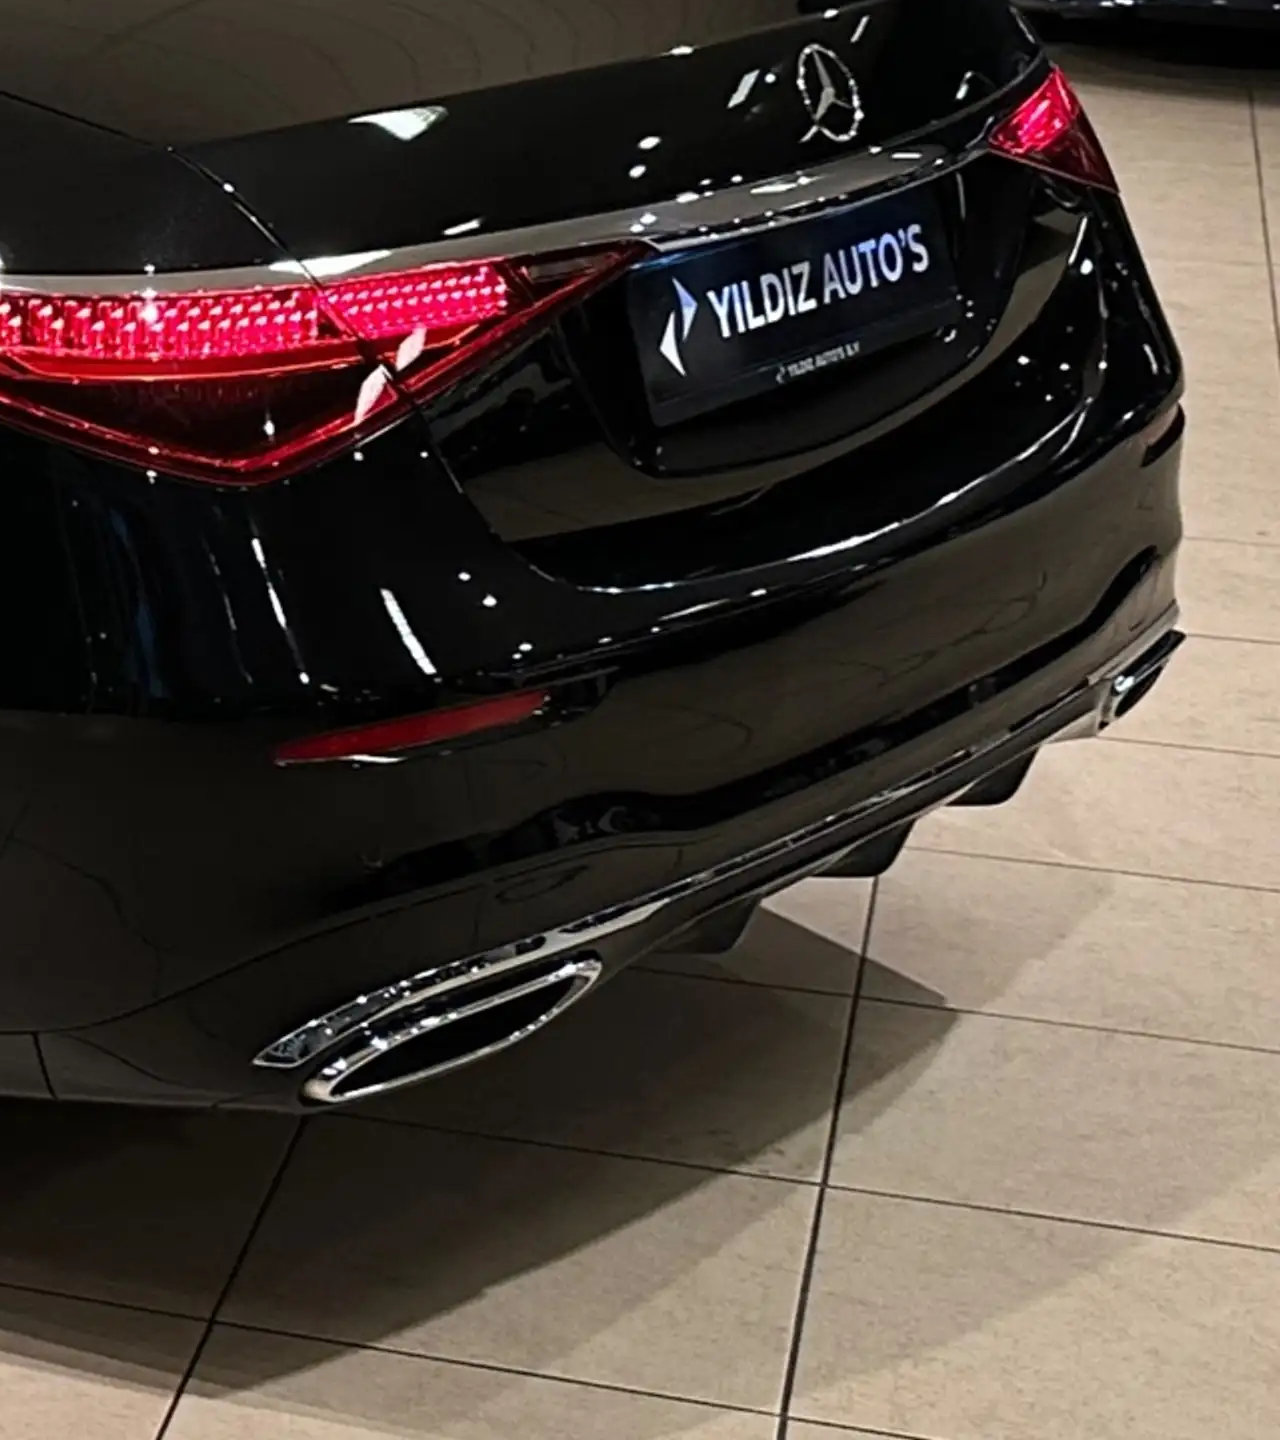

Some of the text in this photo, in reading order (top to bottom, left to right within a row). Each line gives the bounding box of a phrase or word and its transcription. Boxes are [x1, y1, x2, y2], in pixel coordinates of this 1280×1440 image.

[706, 223, 929, 338] YILDIZ AUTO'S
[787, 357, 815, 377] YILDIZ
